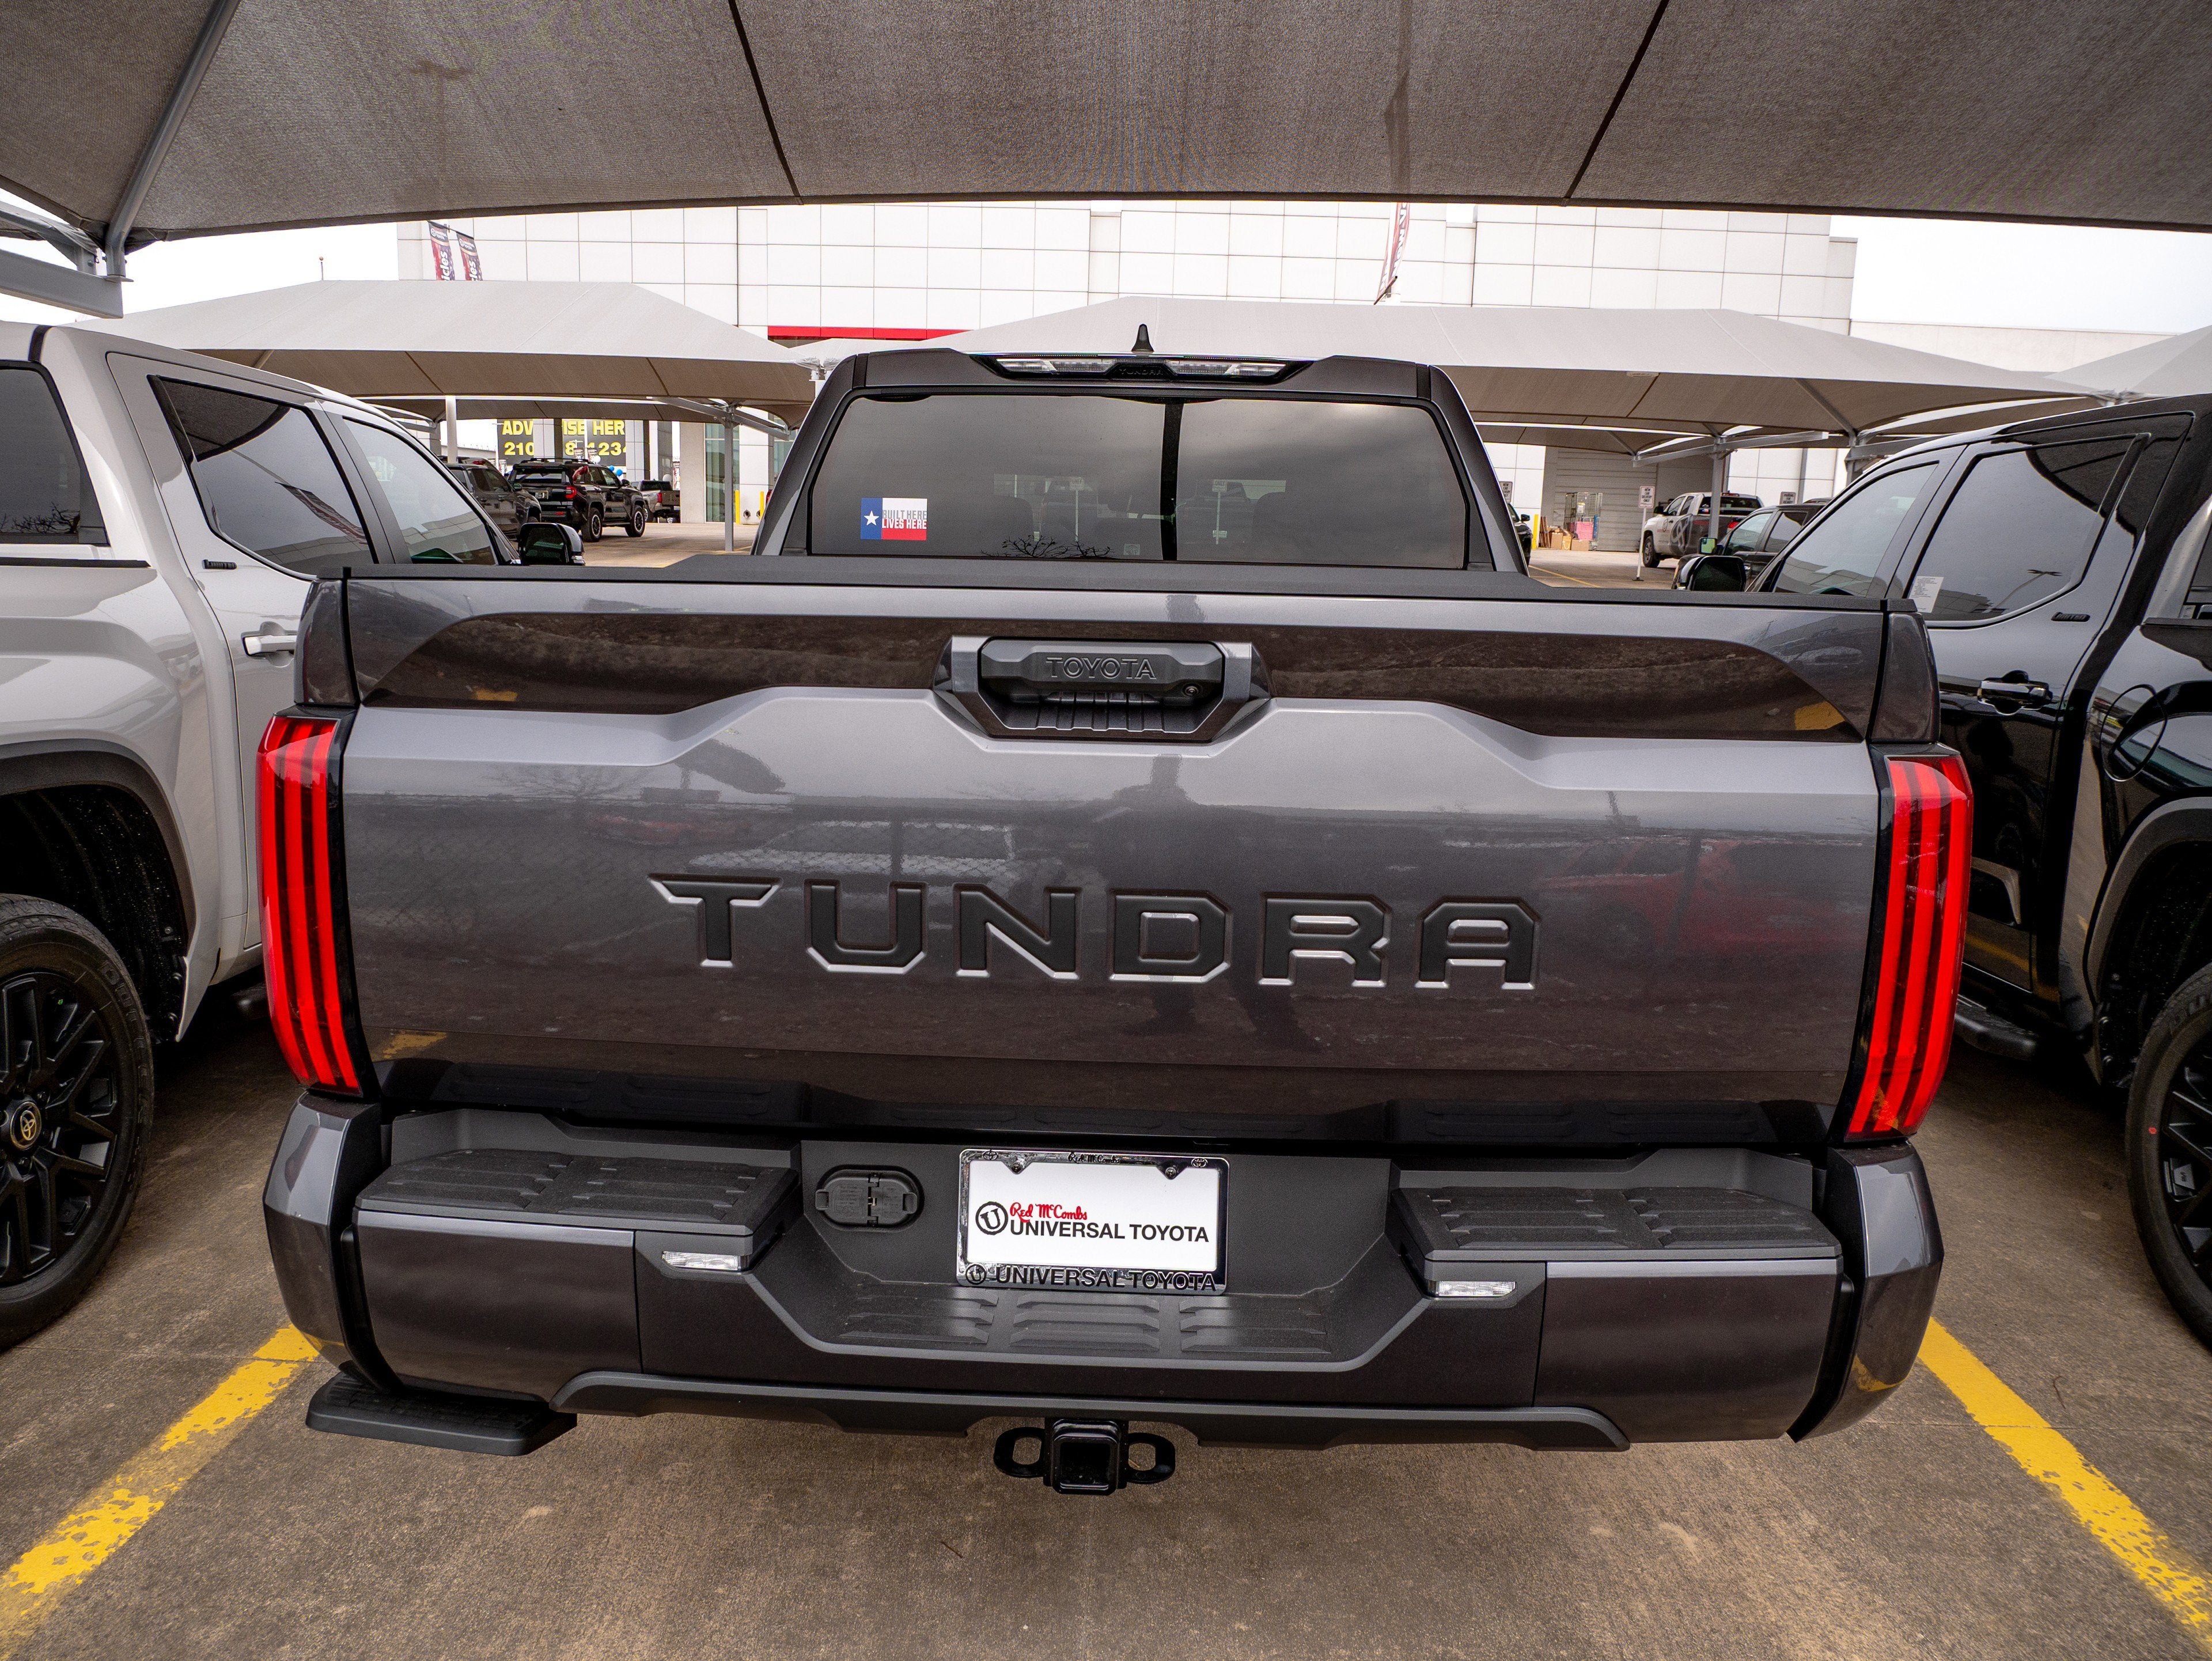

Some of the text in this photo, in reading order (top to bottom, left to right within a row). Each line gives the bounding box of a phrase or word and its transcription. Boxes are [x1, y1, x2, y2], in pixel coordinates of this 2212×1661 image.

[882, 510, 927, 520] BUILT HERE
[882, 519, 927, 529] LIVES HERE
[1046, 657, 1157, 680] TOYOTA
[649, 875, 1541, 991] TUNDRA
[1067, 1152, 1084, 1164] Red
[1010, 1202, 1087, 1223] Red McCombs
[1010, 1220, 1209, 1243] UNIVERSAL TOYOTA
[995, 1265, 1217, 1292] UNIVERSAL TOYOTA
